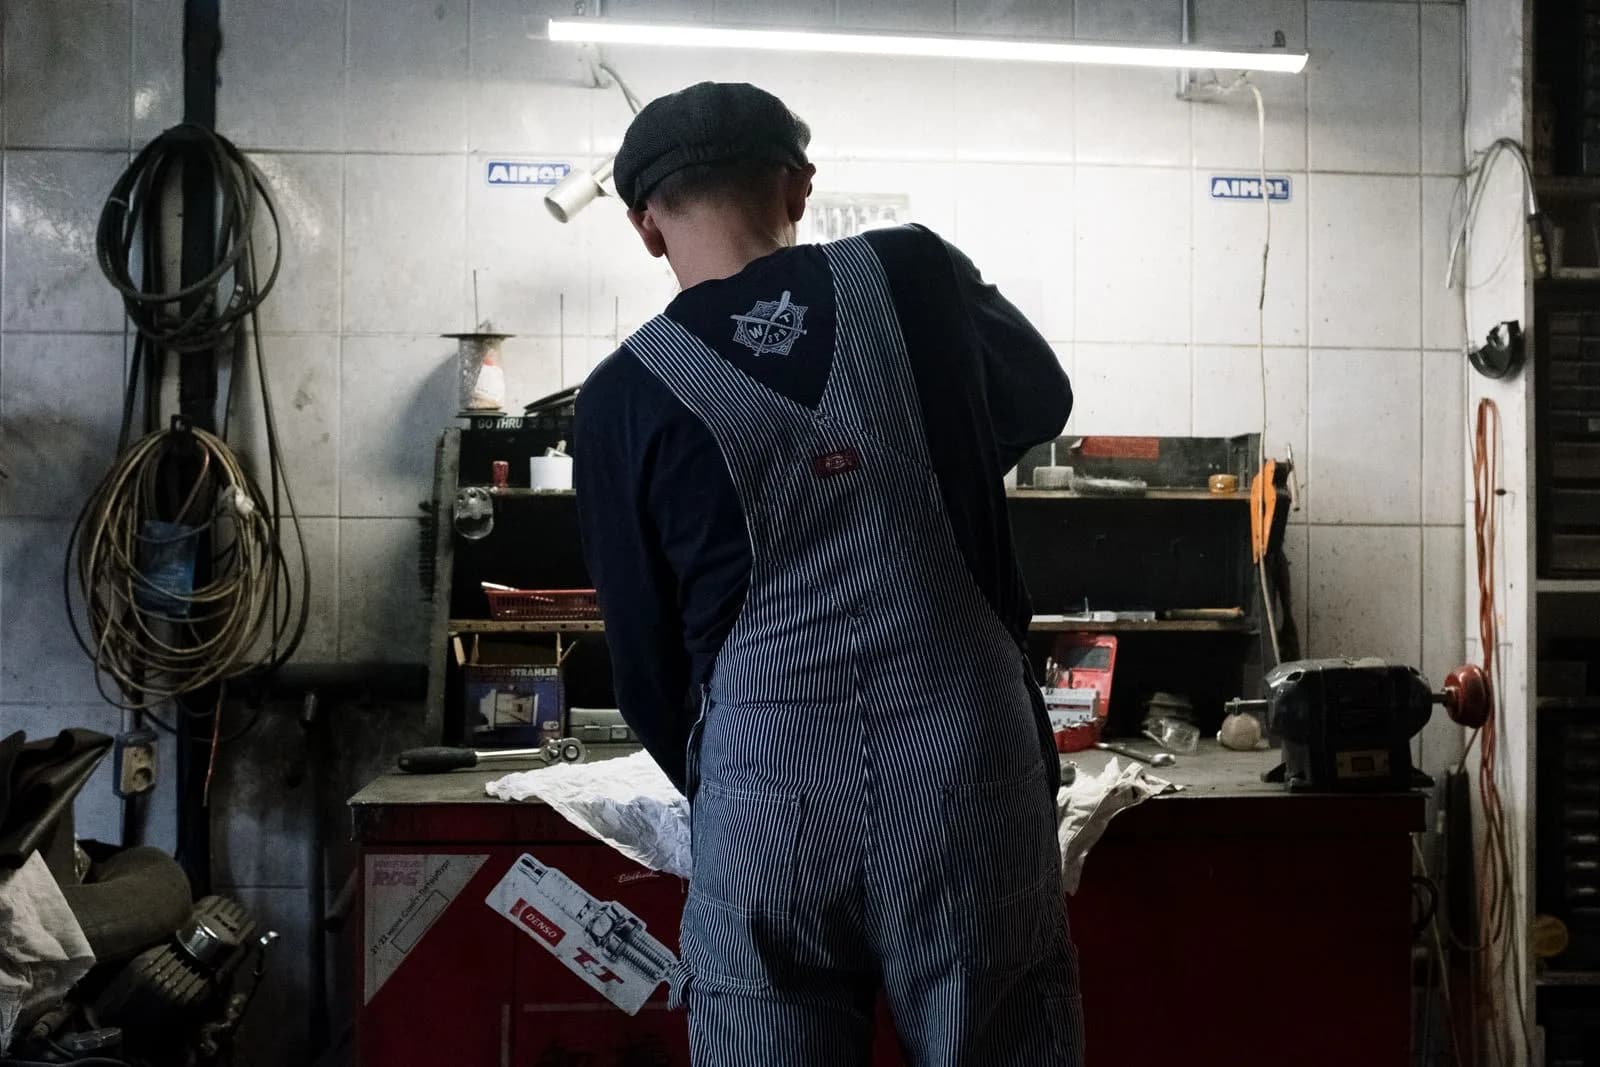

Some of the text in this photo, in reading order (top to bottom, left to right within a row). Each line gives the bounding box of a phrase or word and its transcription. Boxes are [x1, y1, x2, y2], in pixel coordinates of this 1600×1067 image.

[1212, 180, 1288, 197] AIMOL
[496, 418, 523, 429] THRU
[525, 912, 558, 939] DENSO
